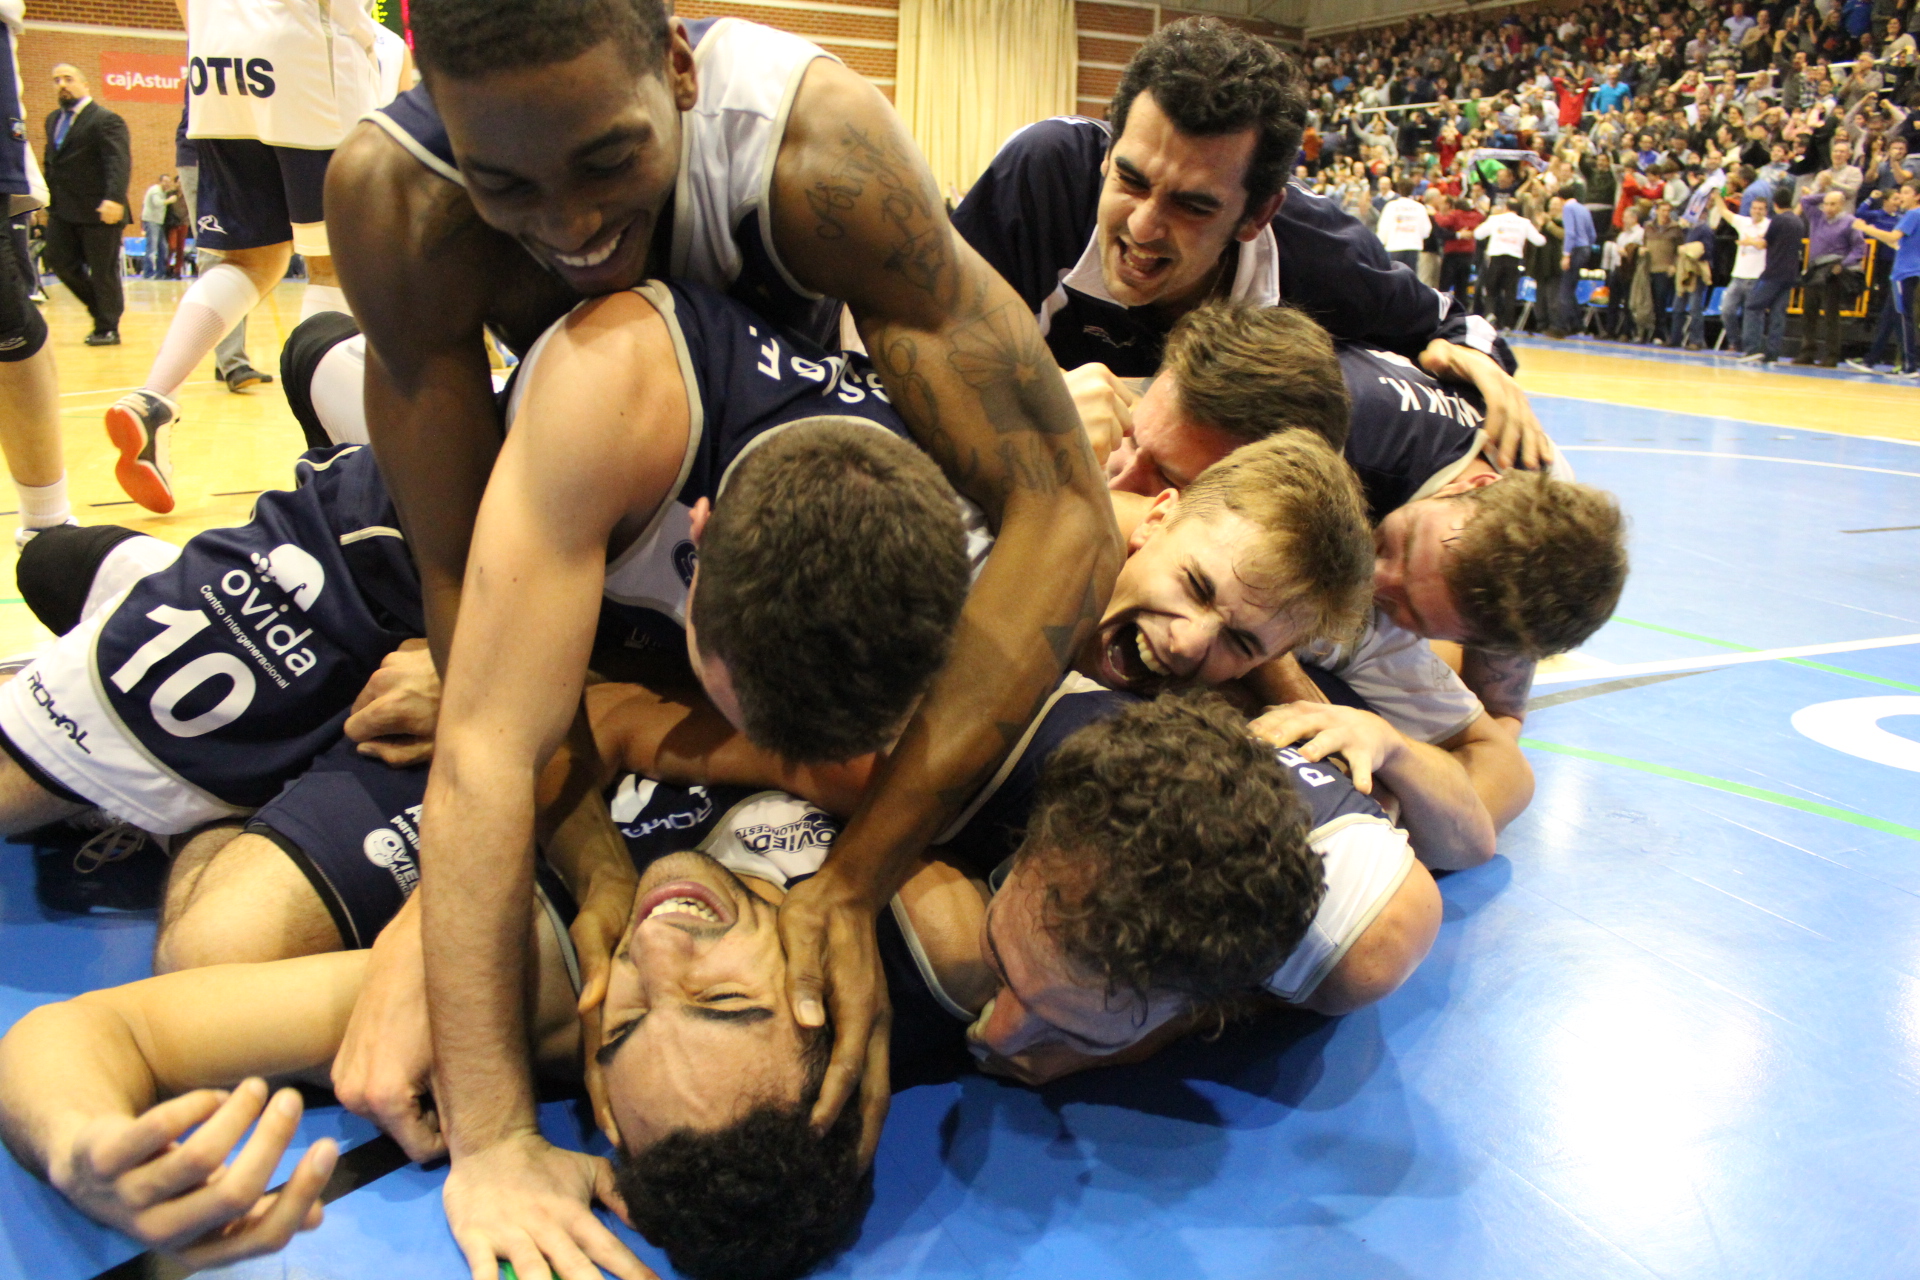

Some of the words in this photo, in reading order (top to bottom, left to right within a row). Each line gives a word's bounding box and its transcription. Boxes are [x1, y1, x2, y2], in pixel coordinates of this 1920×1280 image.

[106, 72, 181, 90] cajAstur
[190, 56, 276, 98] OTIS
[110, 604, 256, 738] 10
[200, 584, 227, 621] Centro
[221, 613, 290, 691] Intergeneracional
[220, 569, 317, 677] ovida
